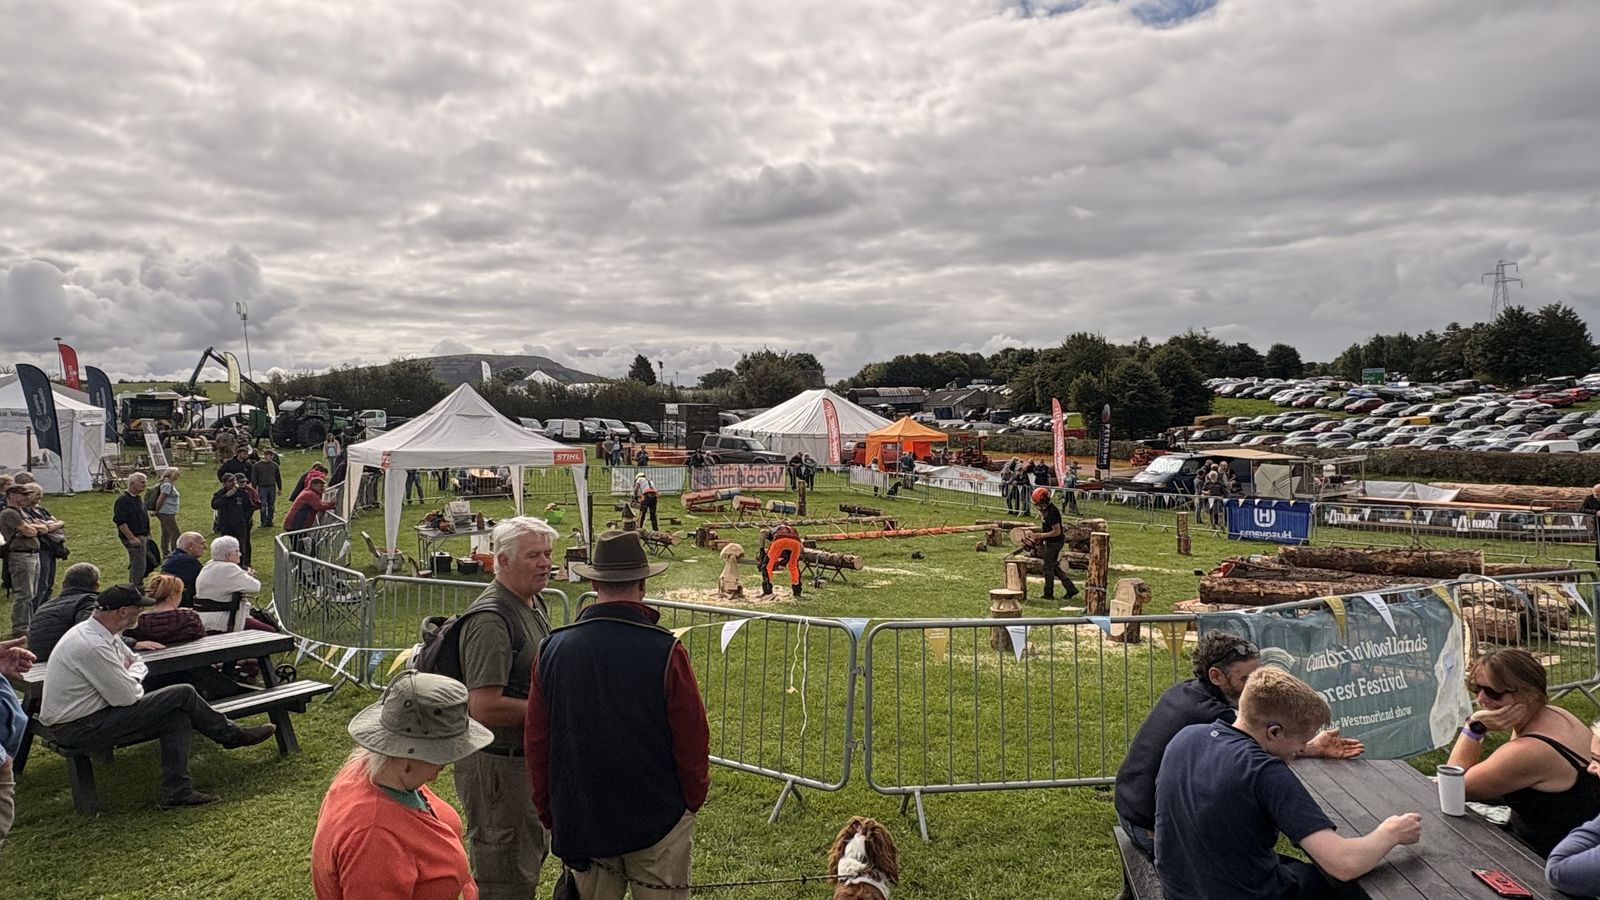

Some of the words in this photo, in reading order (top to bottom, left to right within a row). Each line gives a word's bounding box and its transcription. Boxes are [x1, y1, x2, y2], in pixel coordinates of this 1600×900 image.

[1306, 645, 1361, 672] Cumbria
[1360, 634, 1428, 660] Woodlands
[1358, 670, 1408, 697] Festival
[1340, 707, 1394, 728] Westmorland
[1395, 705, 1412, 718] show
